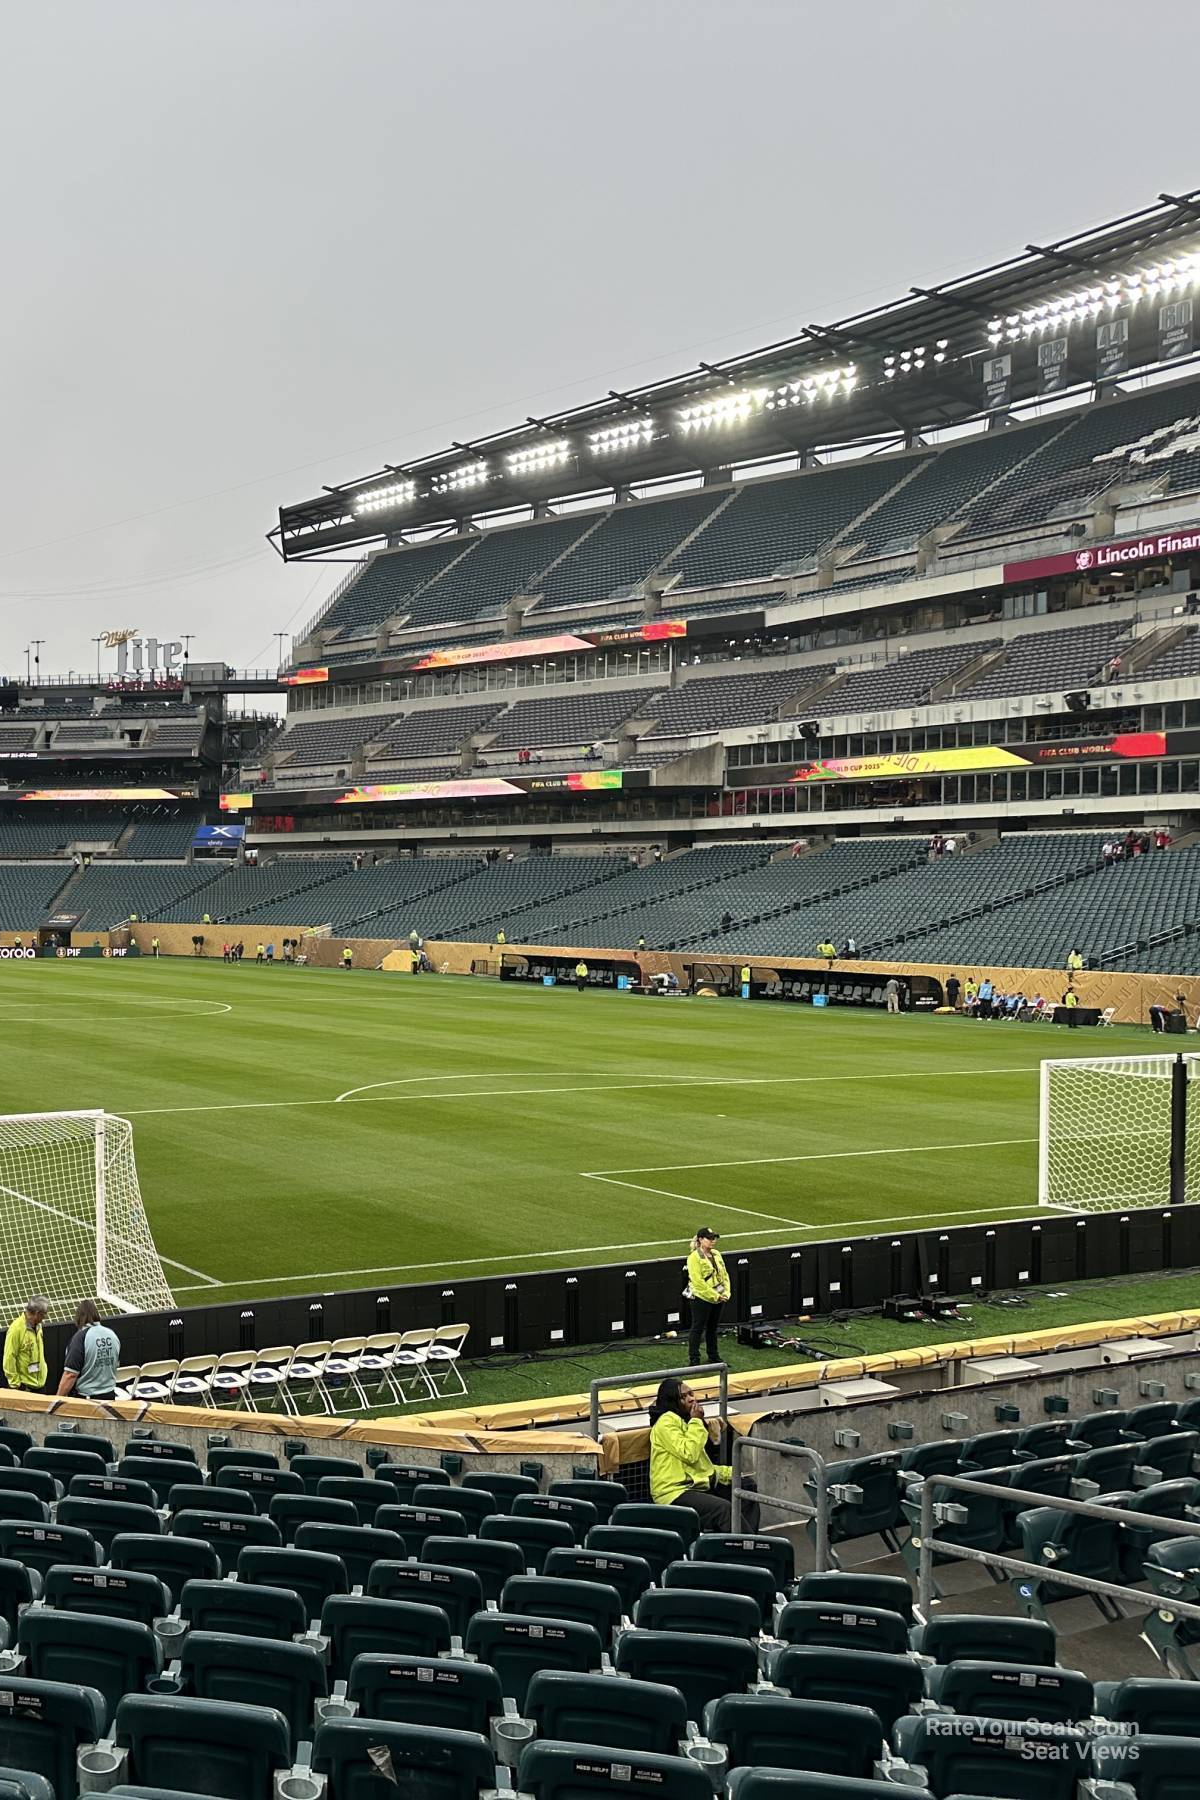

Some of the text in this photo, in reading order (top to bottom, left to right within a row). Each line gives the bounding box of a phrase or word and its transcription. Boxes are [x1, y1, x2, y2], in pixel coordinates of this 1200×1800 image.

[1098, 321, 1127, 349] 44
[1040, 341, 1066, 367] 92
[992, 360, 1003, 382] 5
[1098, 542, 1154, 564] Lincoln
[100, 629, 139, 648] Miller
[113, 638, 182, 679] Lite
[1059, 747, 1079, 755] CLUB
[67, 948, 81, 957] PIF
[112, 948, 127, 957] PIF
[96, 1337, 112, 1348] CSC
